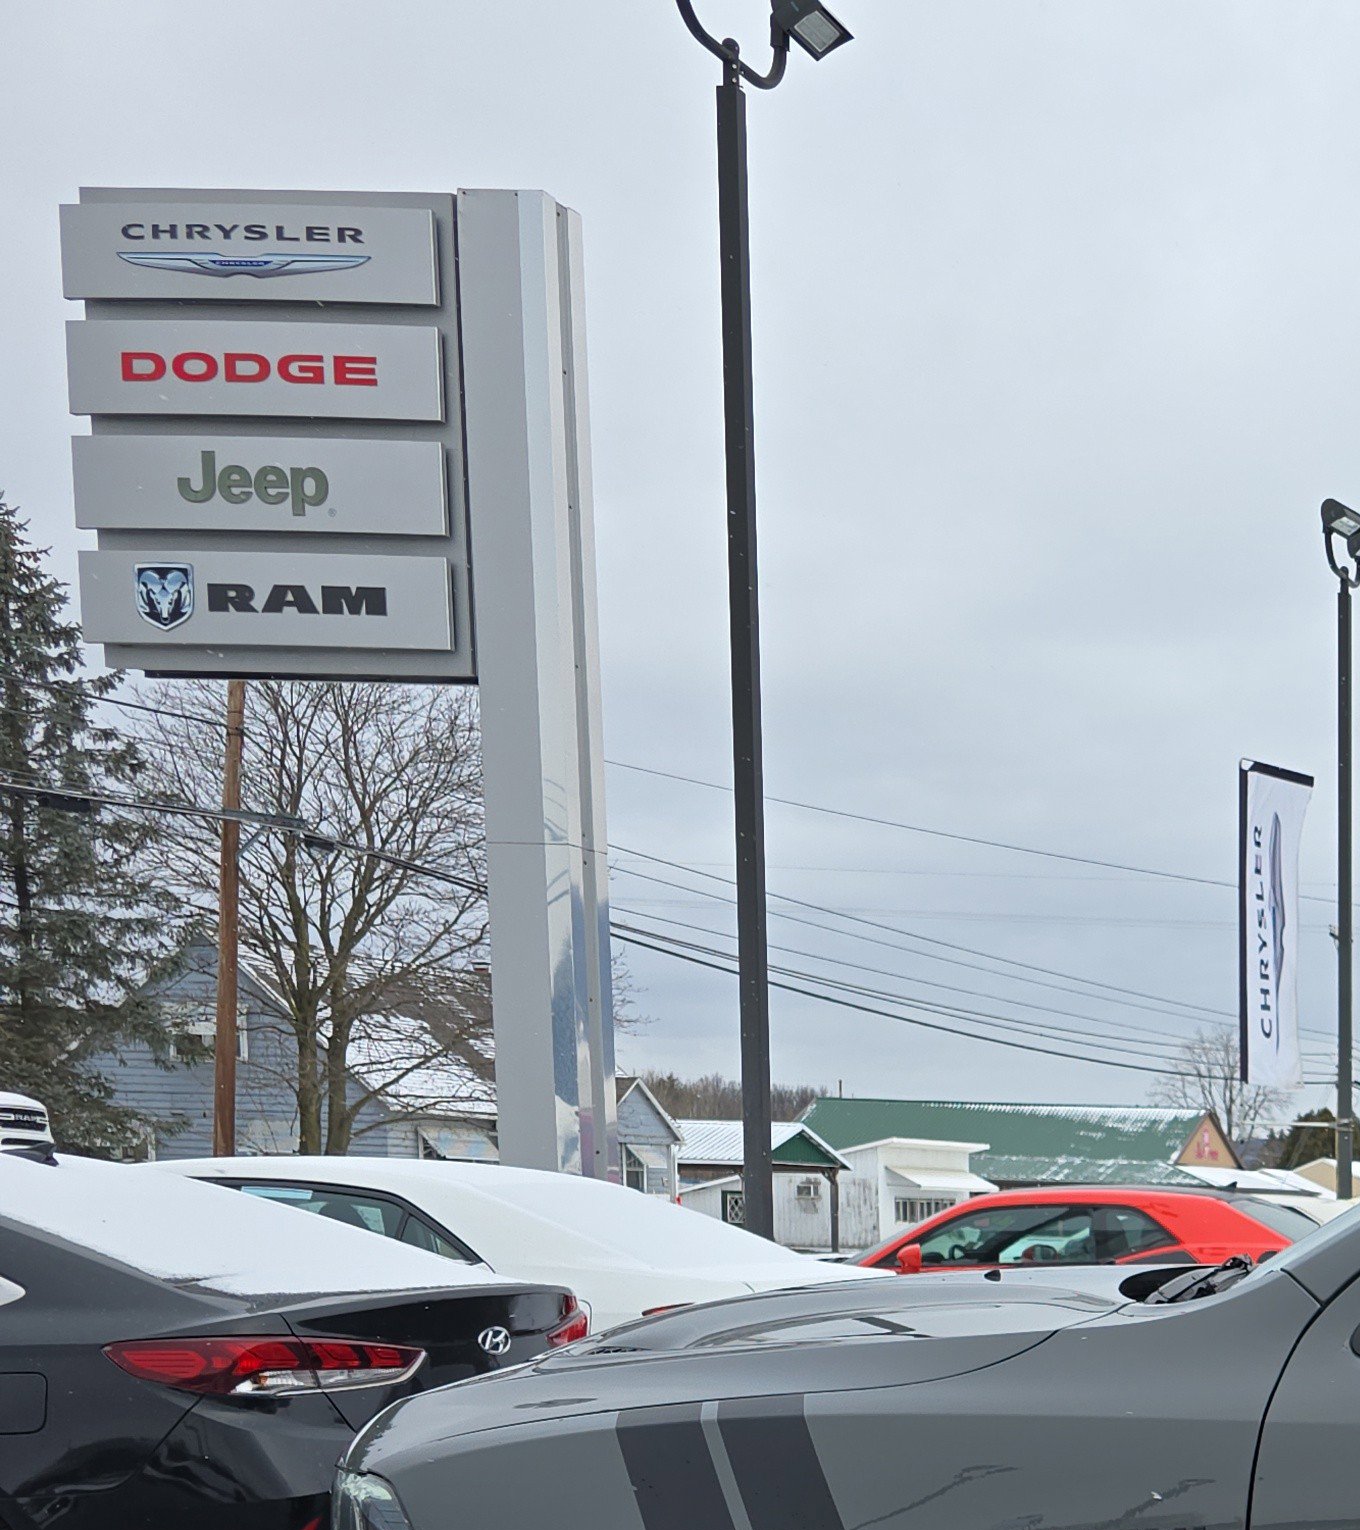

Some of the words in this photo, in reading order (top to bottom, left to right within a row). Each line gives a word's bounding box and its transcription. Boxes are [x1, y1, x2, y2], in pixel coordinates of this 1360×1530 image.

[121, 223, 365, 243] CHRYSLER
[121, 351, 378, 387] DODGE
[176, 450, 330, 517] Jeep
[206, 582, 388, 617] RAM
[1253, 825, 1273, 1040] CHRYSLER
